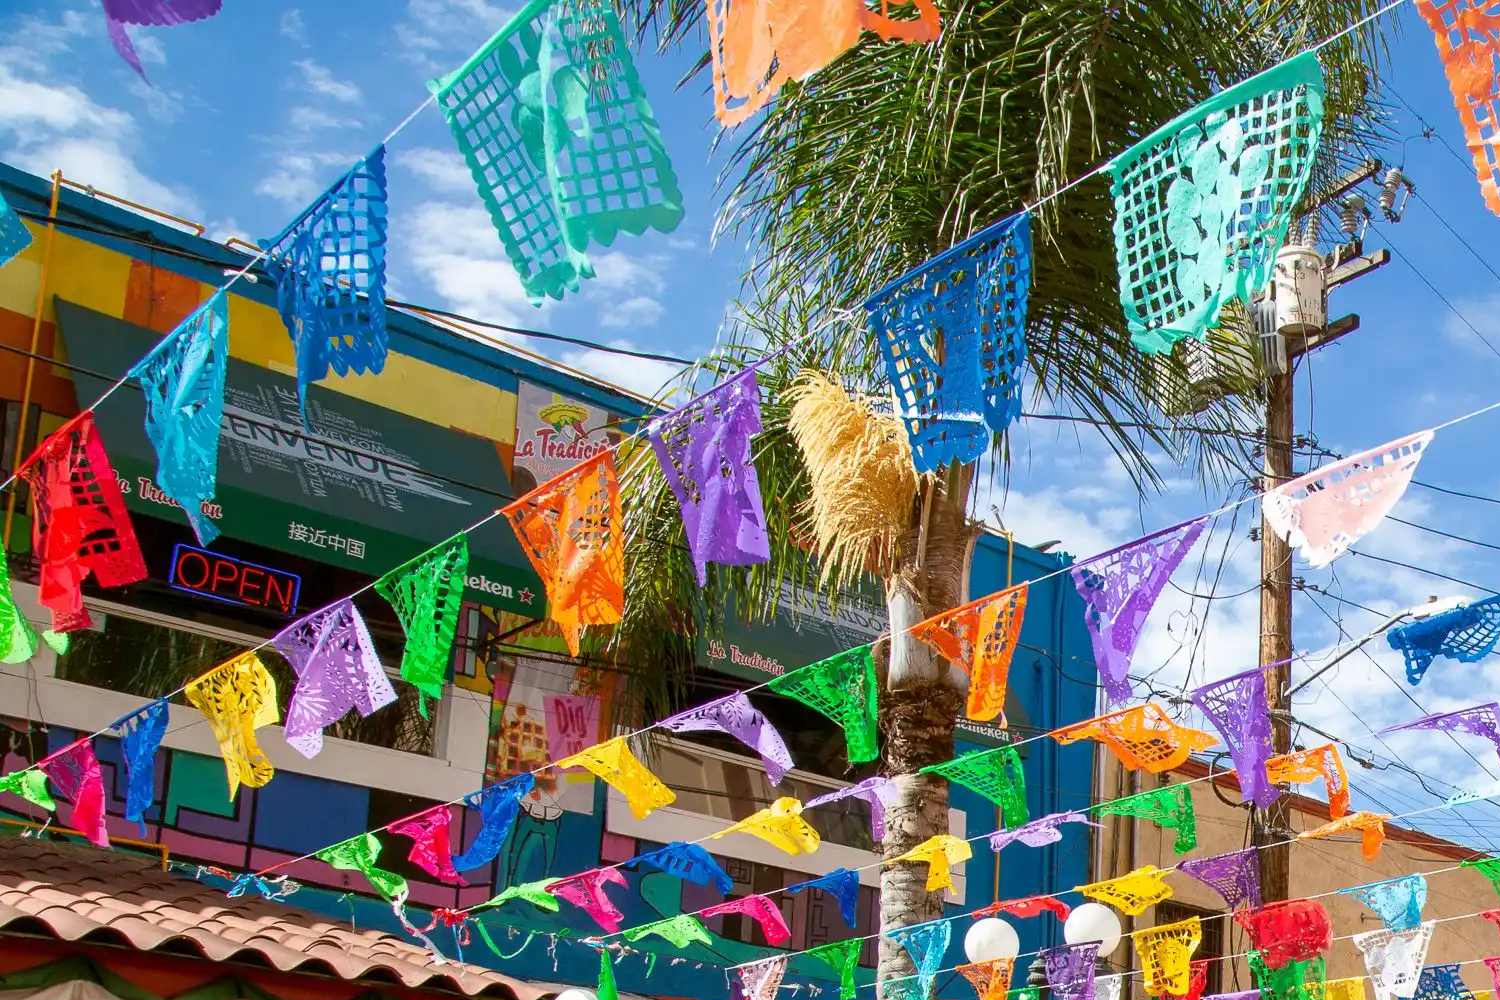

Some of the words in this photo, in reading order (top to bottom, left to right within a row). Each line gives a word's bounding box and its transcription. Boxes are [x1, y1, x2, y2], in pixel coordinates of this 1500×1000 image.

[307, 423, 388, 454] WELKOM
[514, 425, 535, 459] La
[288, 521, 366, 559] 接近中国
[177, 552, 294, 612] OPEN
[706, 639, 726, 660] La
[729, 644, 785, 676] Tradición
[552, 699, 588, 737] Dig
